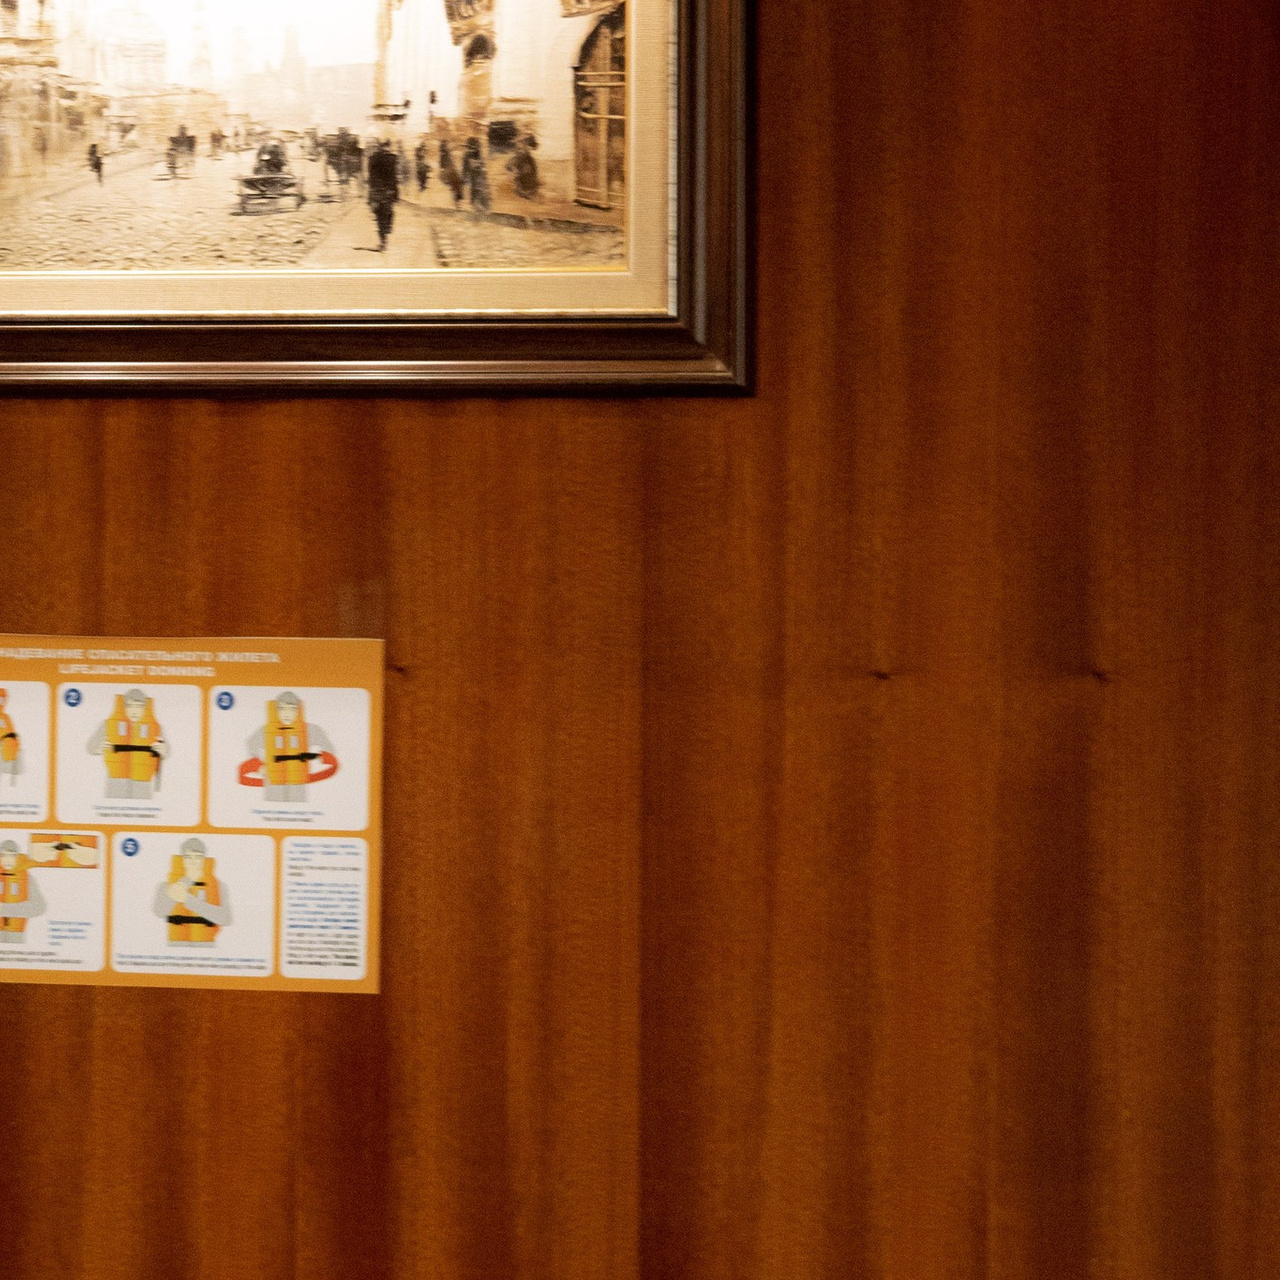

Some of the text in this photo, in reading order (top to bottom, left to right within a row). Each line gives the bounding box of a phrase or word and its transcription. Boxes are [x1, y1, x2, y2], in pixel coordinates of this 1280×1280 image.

[86, 649, 214, 662] СПАСАТЕЛЬНОГО
[216, 652, 280, 663] ЖИЛЕТА
[58, 664, 216, 677] LIFEJACKET DONNING
